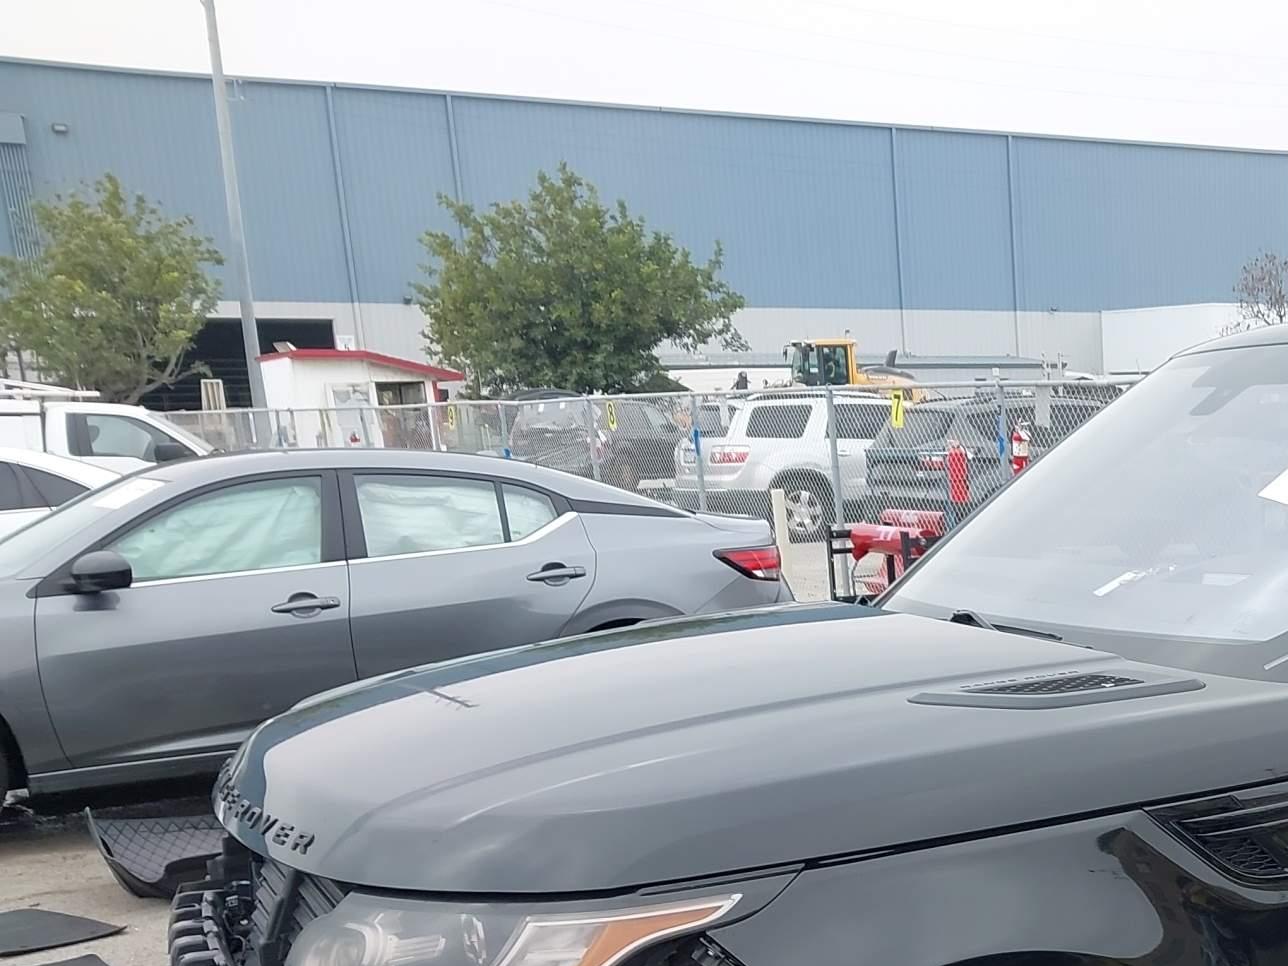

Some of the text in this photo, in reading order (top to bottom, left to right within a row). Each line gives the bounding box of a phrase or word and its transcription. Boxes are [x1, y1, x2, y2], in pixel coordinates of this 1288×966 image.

[607, 402, 615, 425] 8
[893, 394, 901, 422] 7
[234, 799, 316, 855] ROVER
